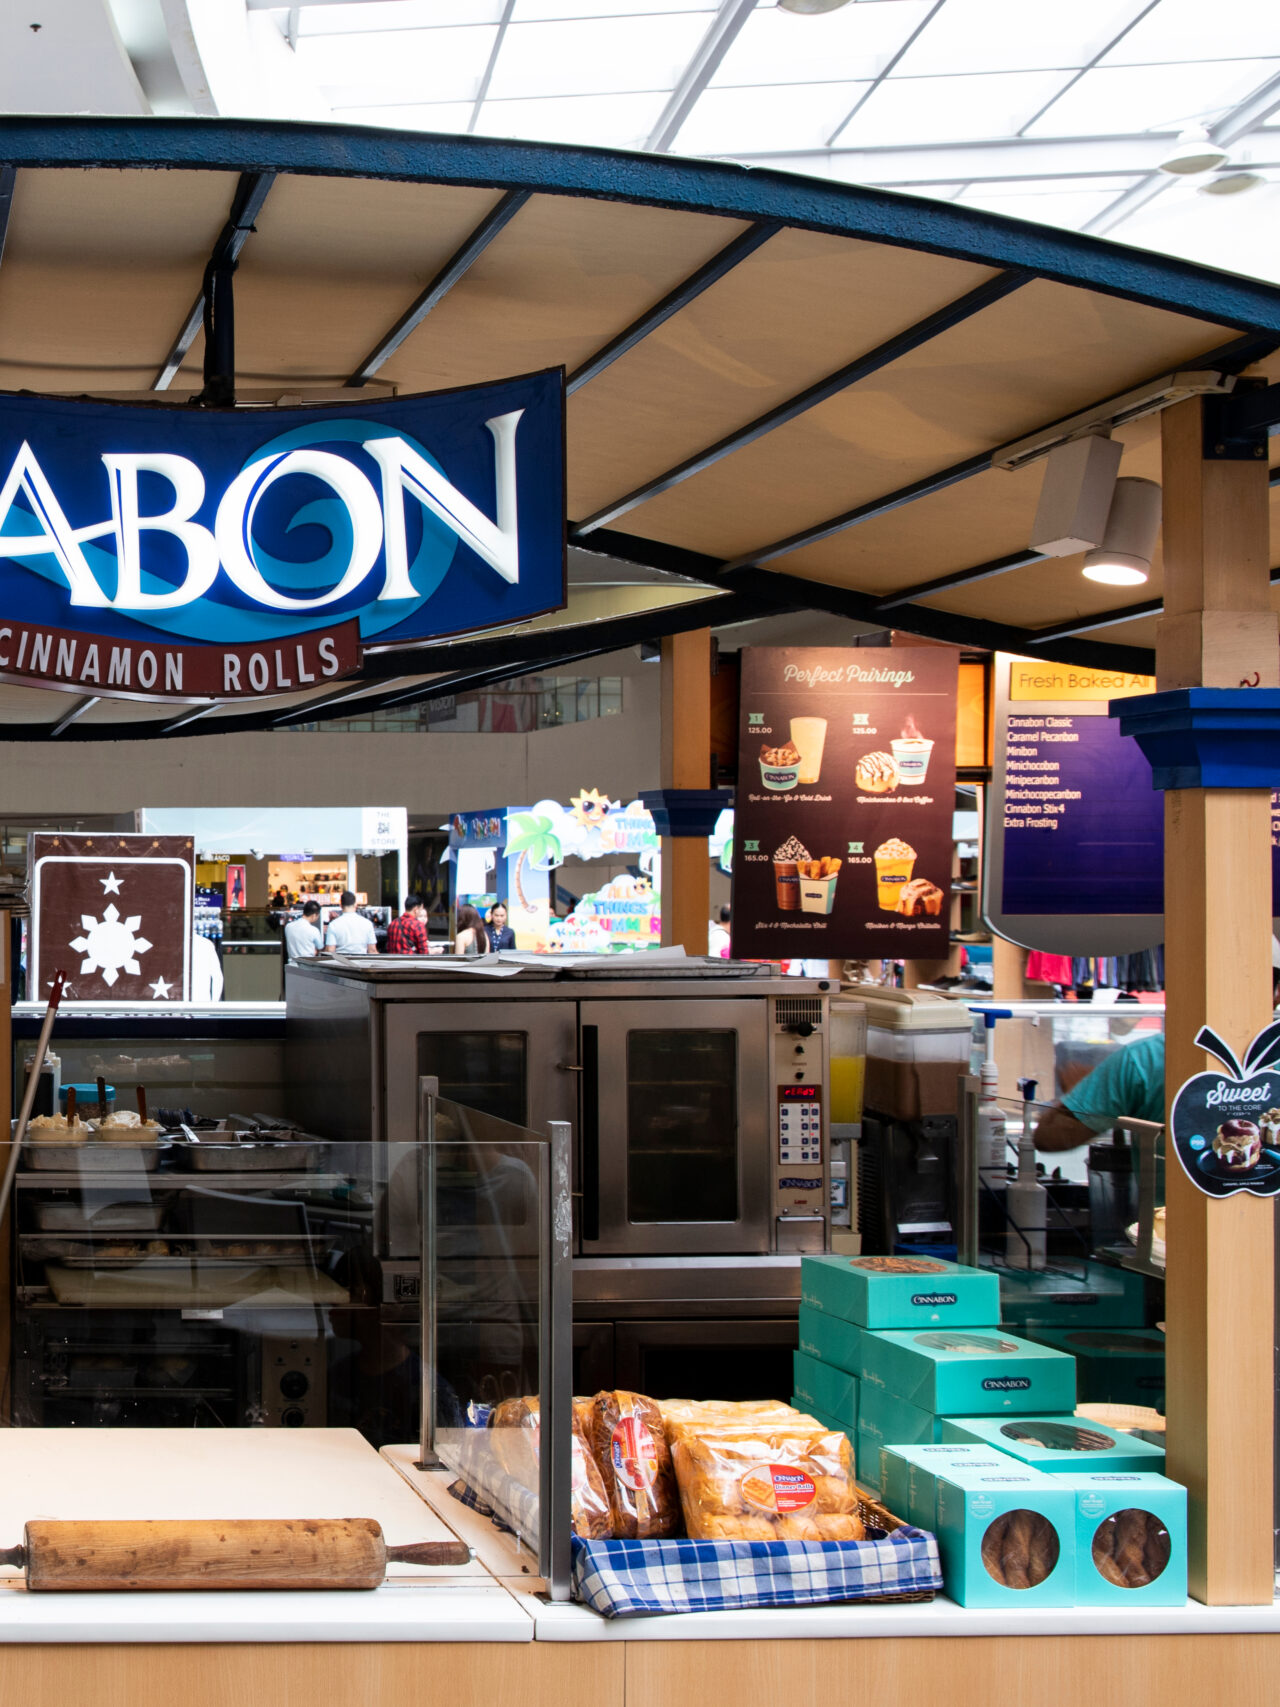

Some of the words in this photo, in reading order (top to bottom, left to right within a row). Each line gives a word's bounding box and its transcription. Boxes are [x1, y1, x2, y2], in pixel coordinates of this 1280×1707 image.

[224, 638, 339, 691] ROLLS
[784, 665, 844, 687] Perfect
[847, 665, 914, 688] Pairings
[1019, 673, 1063, 688] Fresh
[1068, 673, 1124, 688] Baked
[1008, 717, 1044, 727] Cinnabon
[1045, 717, 1073, 727] Classic
[1007, 731, 1039, 741] Caramel
[1040, 731, 1079, 741] Pecanbon
[1006, 746, 1038, 756] Minibon
[1006, 760, 1060, 771] Minichocobon
[1006, 774, 1060, 786] Minipecanbon
[1005, 789, 1081, 801] Minichocopecanbon
[1005, 803, 1042, 814] Cinnabon
[1004, 817, 1024, 828] Extra
[1026, 817, 1058, 830] Frosting
[744, 854, 768, 862] 165.00
[848, 856, 872, 864] 165.00
[593, 901, 649, 915] THINGS
[1206, 1080, 1272, 1109] Sweet
[1242, 1103, 1263, 1111] CORE
[913, 1294, 956, 1305] CINNABON
[983, 1379, 1029, 1390] CINNABON
